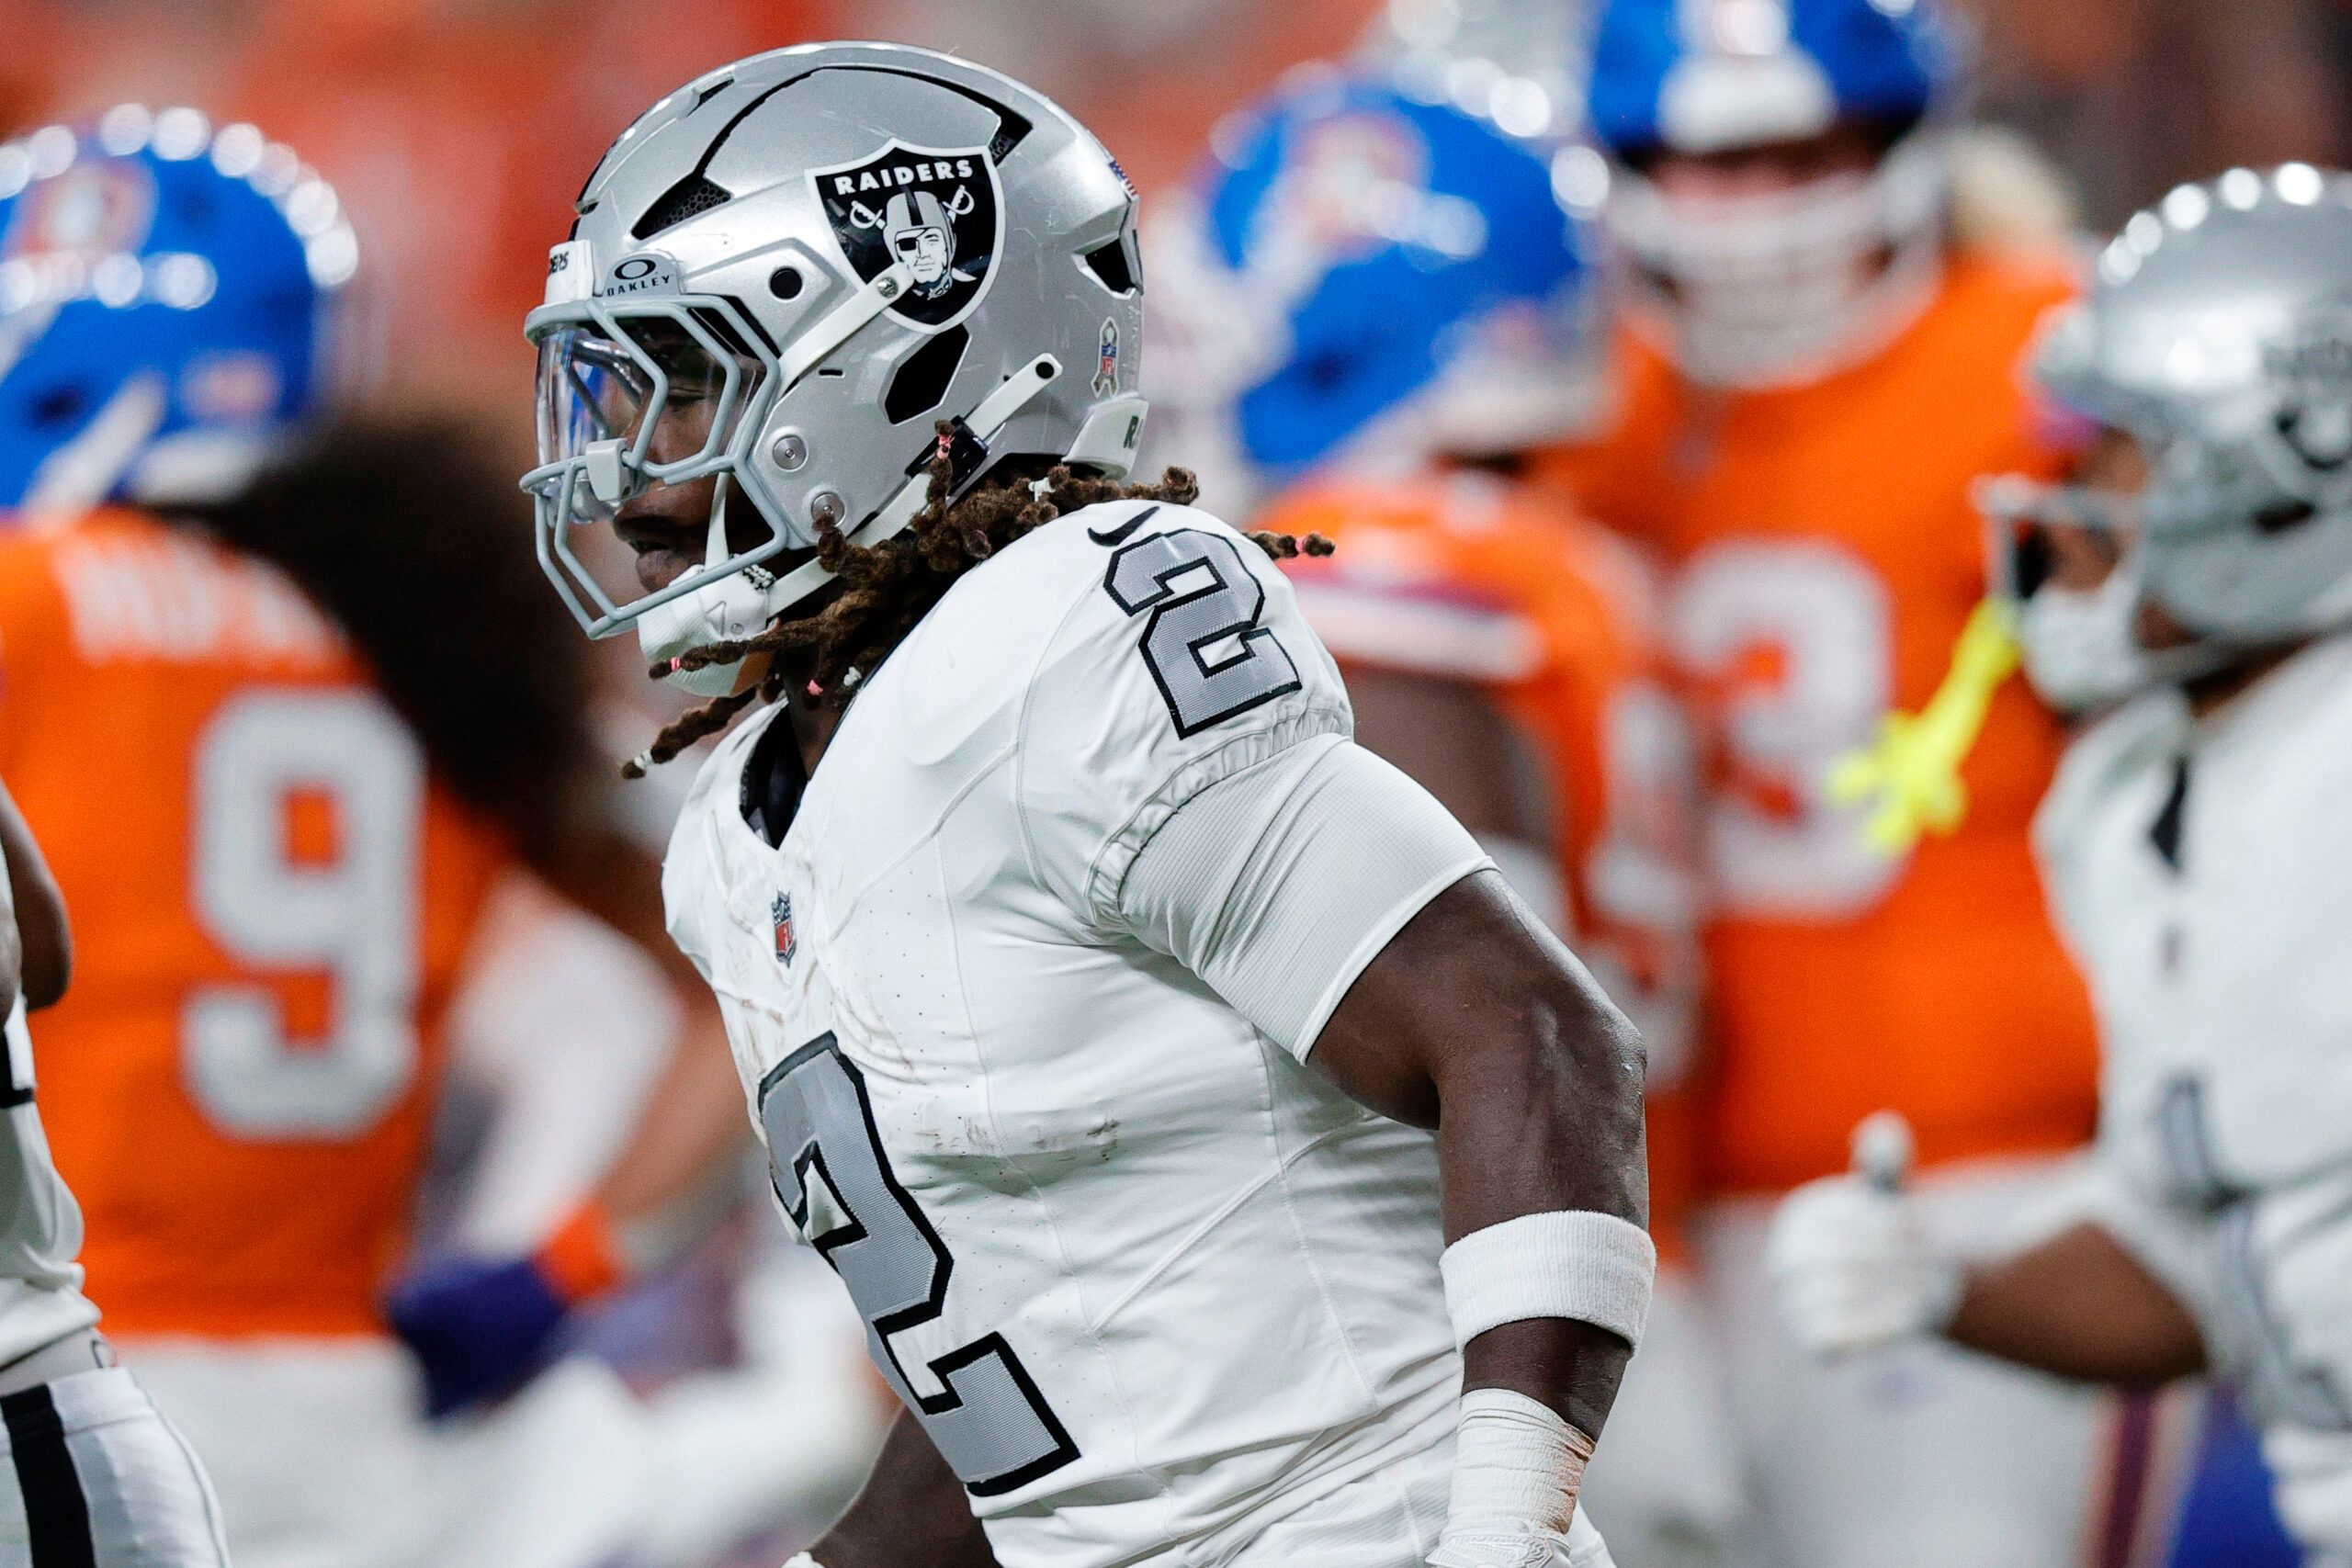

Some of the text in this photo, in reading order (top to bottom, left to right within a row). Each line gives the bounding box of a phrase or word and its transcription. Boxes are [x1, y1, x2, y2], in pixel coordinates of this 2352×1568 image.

[833, 159, 973, 196] RAIDERS
[607, 276, 670, 297] OAKLEY
[1102, 527, 1303, 740] 2
[182, 685, 425, 1140] 9
[757, 1030, 1081, 1497] 2
